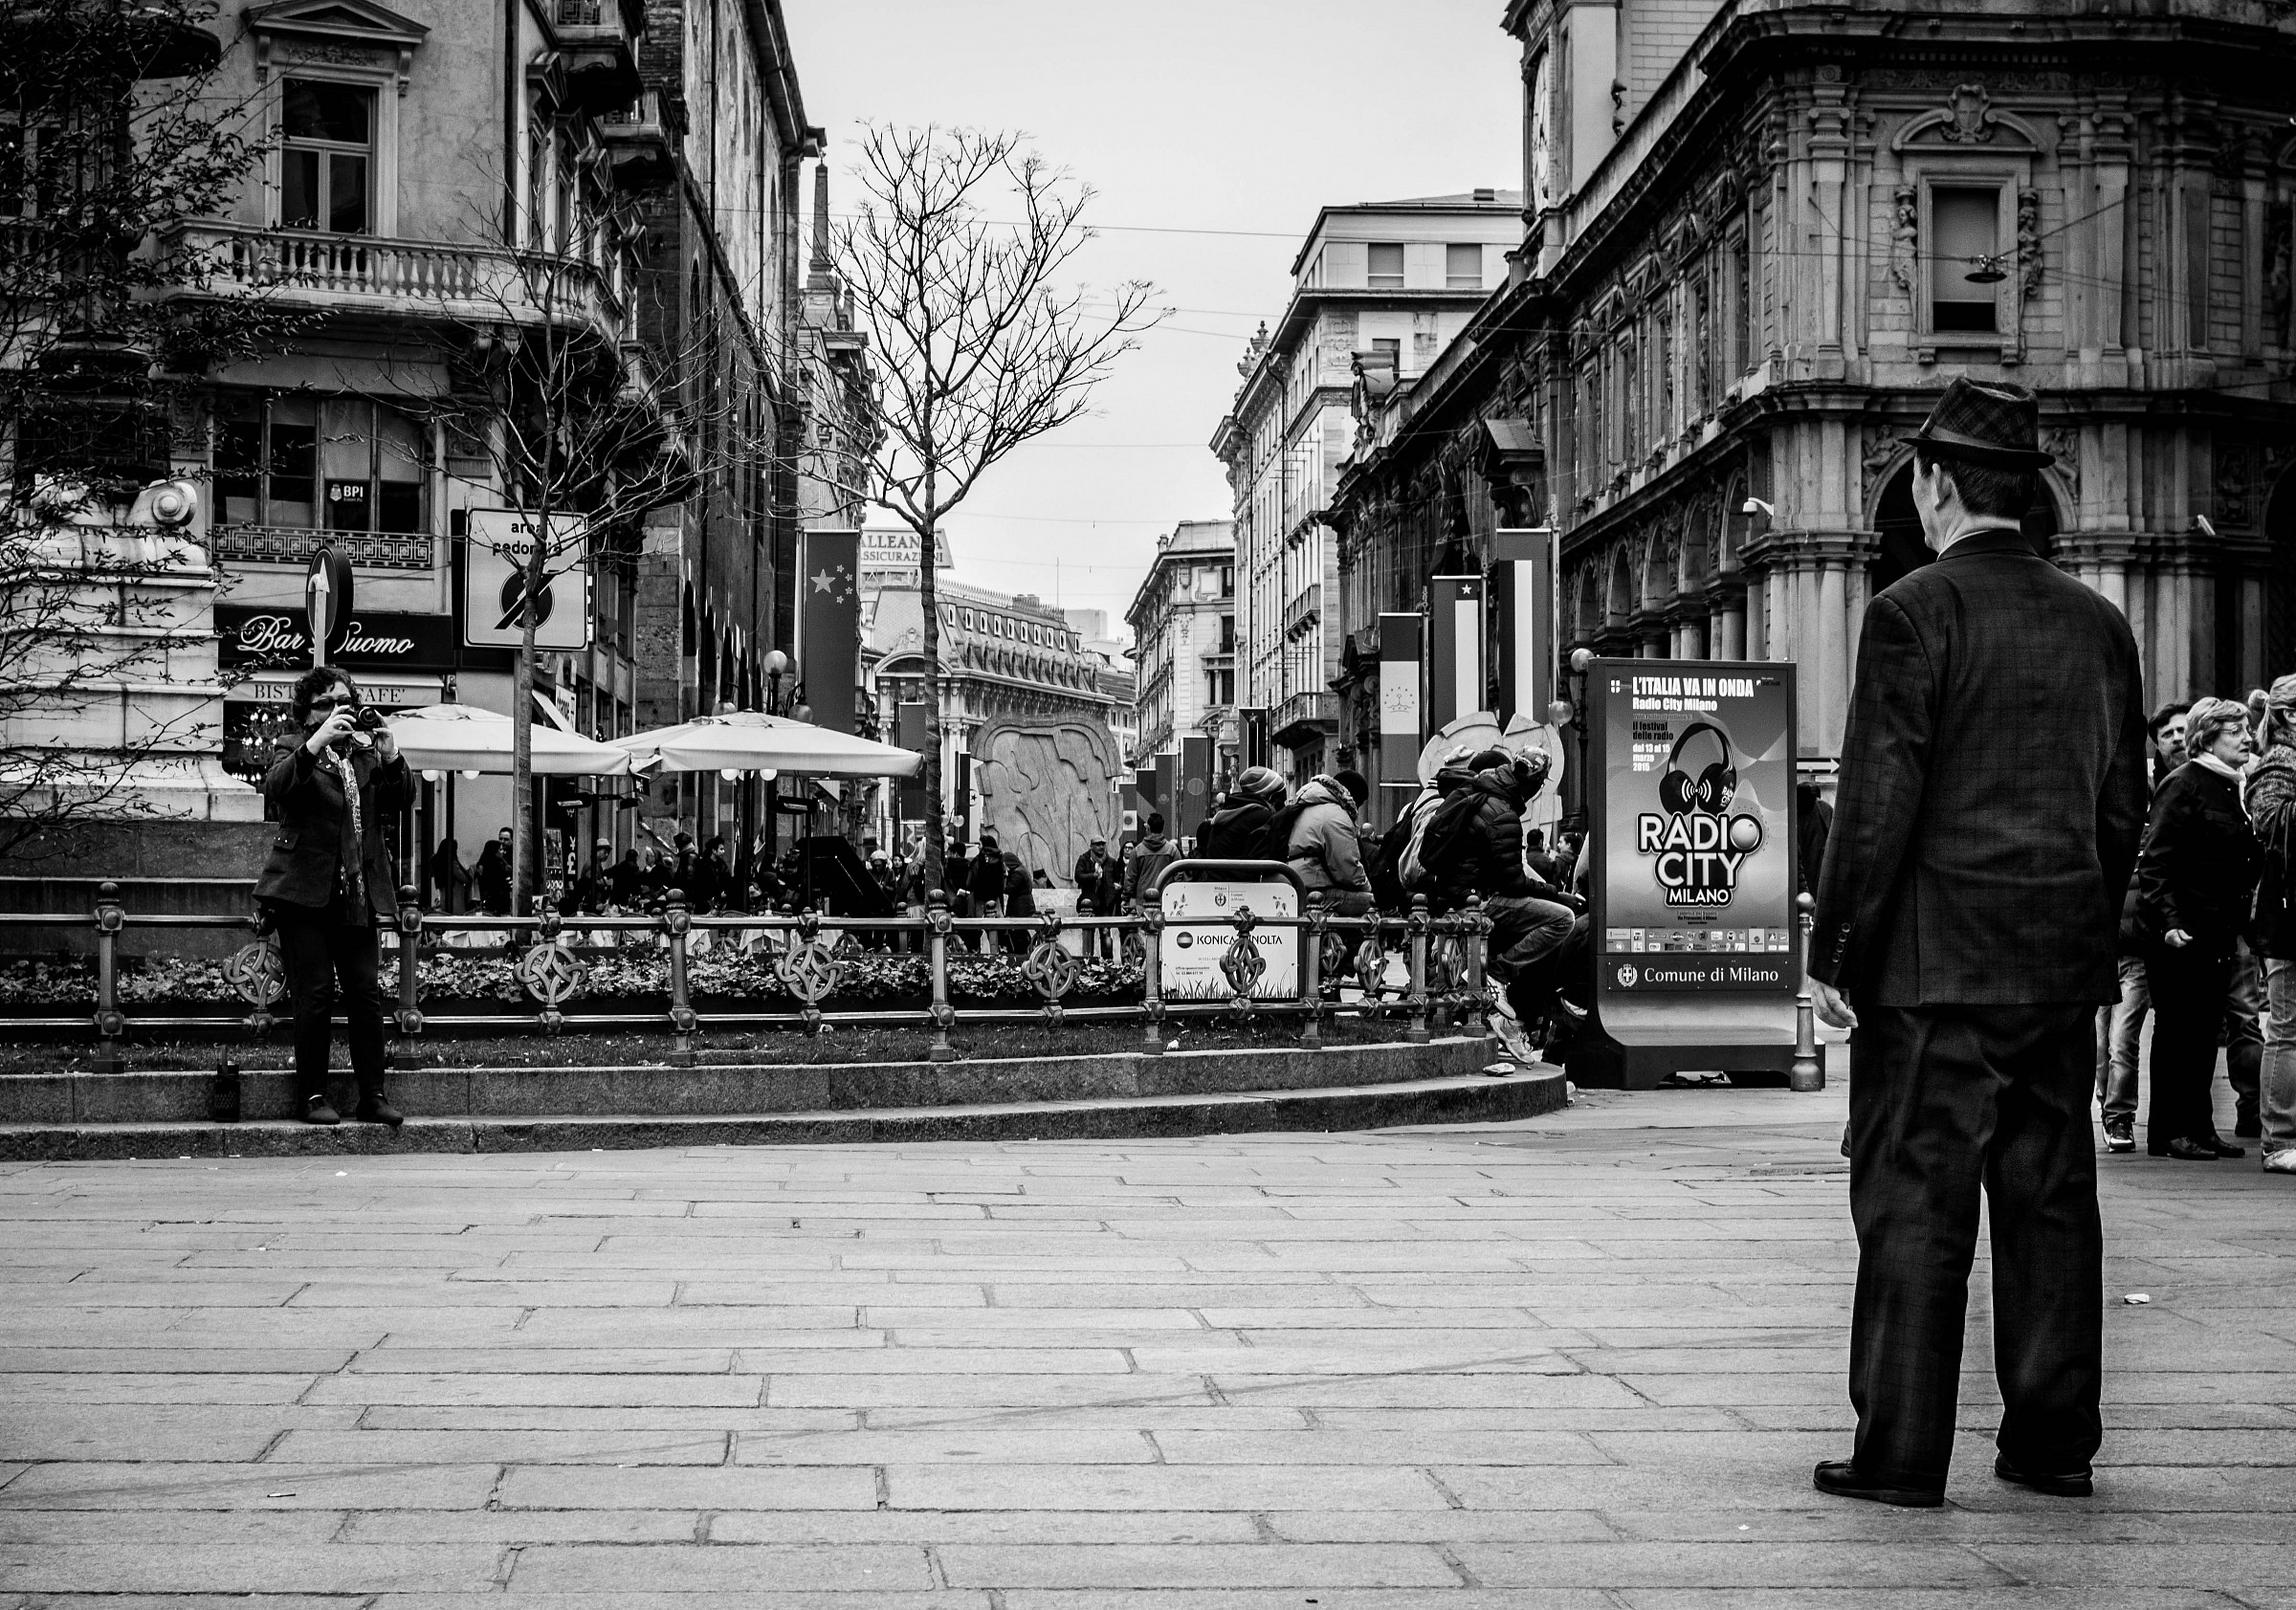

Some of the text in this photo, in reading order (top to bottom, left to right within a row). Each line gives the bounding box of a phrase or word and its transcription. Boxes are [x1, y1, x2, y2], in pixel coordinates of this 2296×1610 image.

[343, 485, 364, 497] BPI
[236, 615, 306, 651] Bar
[1632, 676, 1755, 697] L'ITALIA VA IN ONDA
[1632, 696, 1718, 712] Radio City Milano
[1639, 721, 1667, 731] festival
[1632, 732, 1674, 740] delle radio
[1632, 743, 1670, 753] dal 13 al 15
[1632, 754, 1654, 762] marzo
[1632, 762, 1650, 771] 2015
[1640, 814, 1761, 850] RADIO
[1657, 851, 1743, 887] CITY
[1668, 889, 1730, 903] MILANO
[1197, 935, 1235, 945] KONICA
[1645, 967, 1779, 981] Comune di Milano
